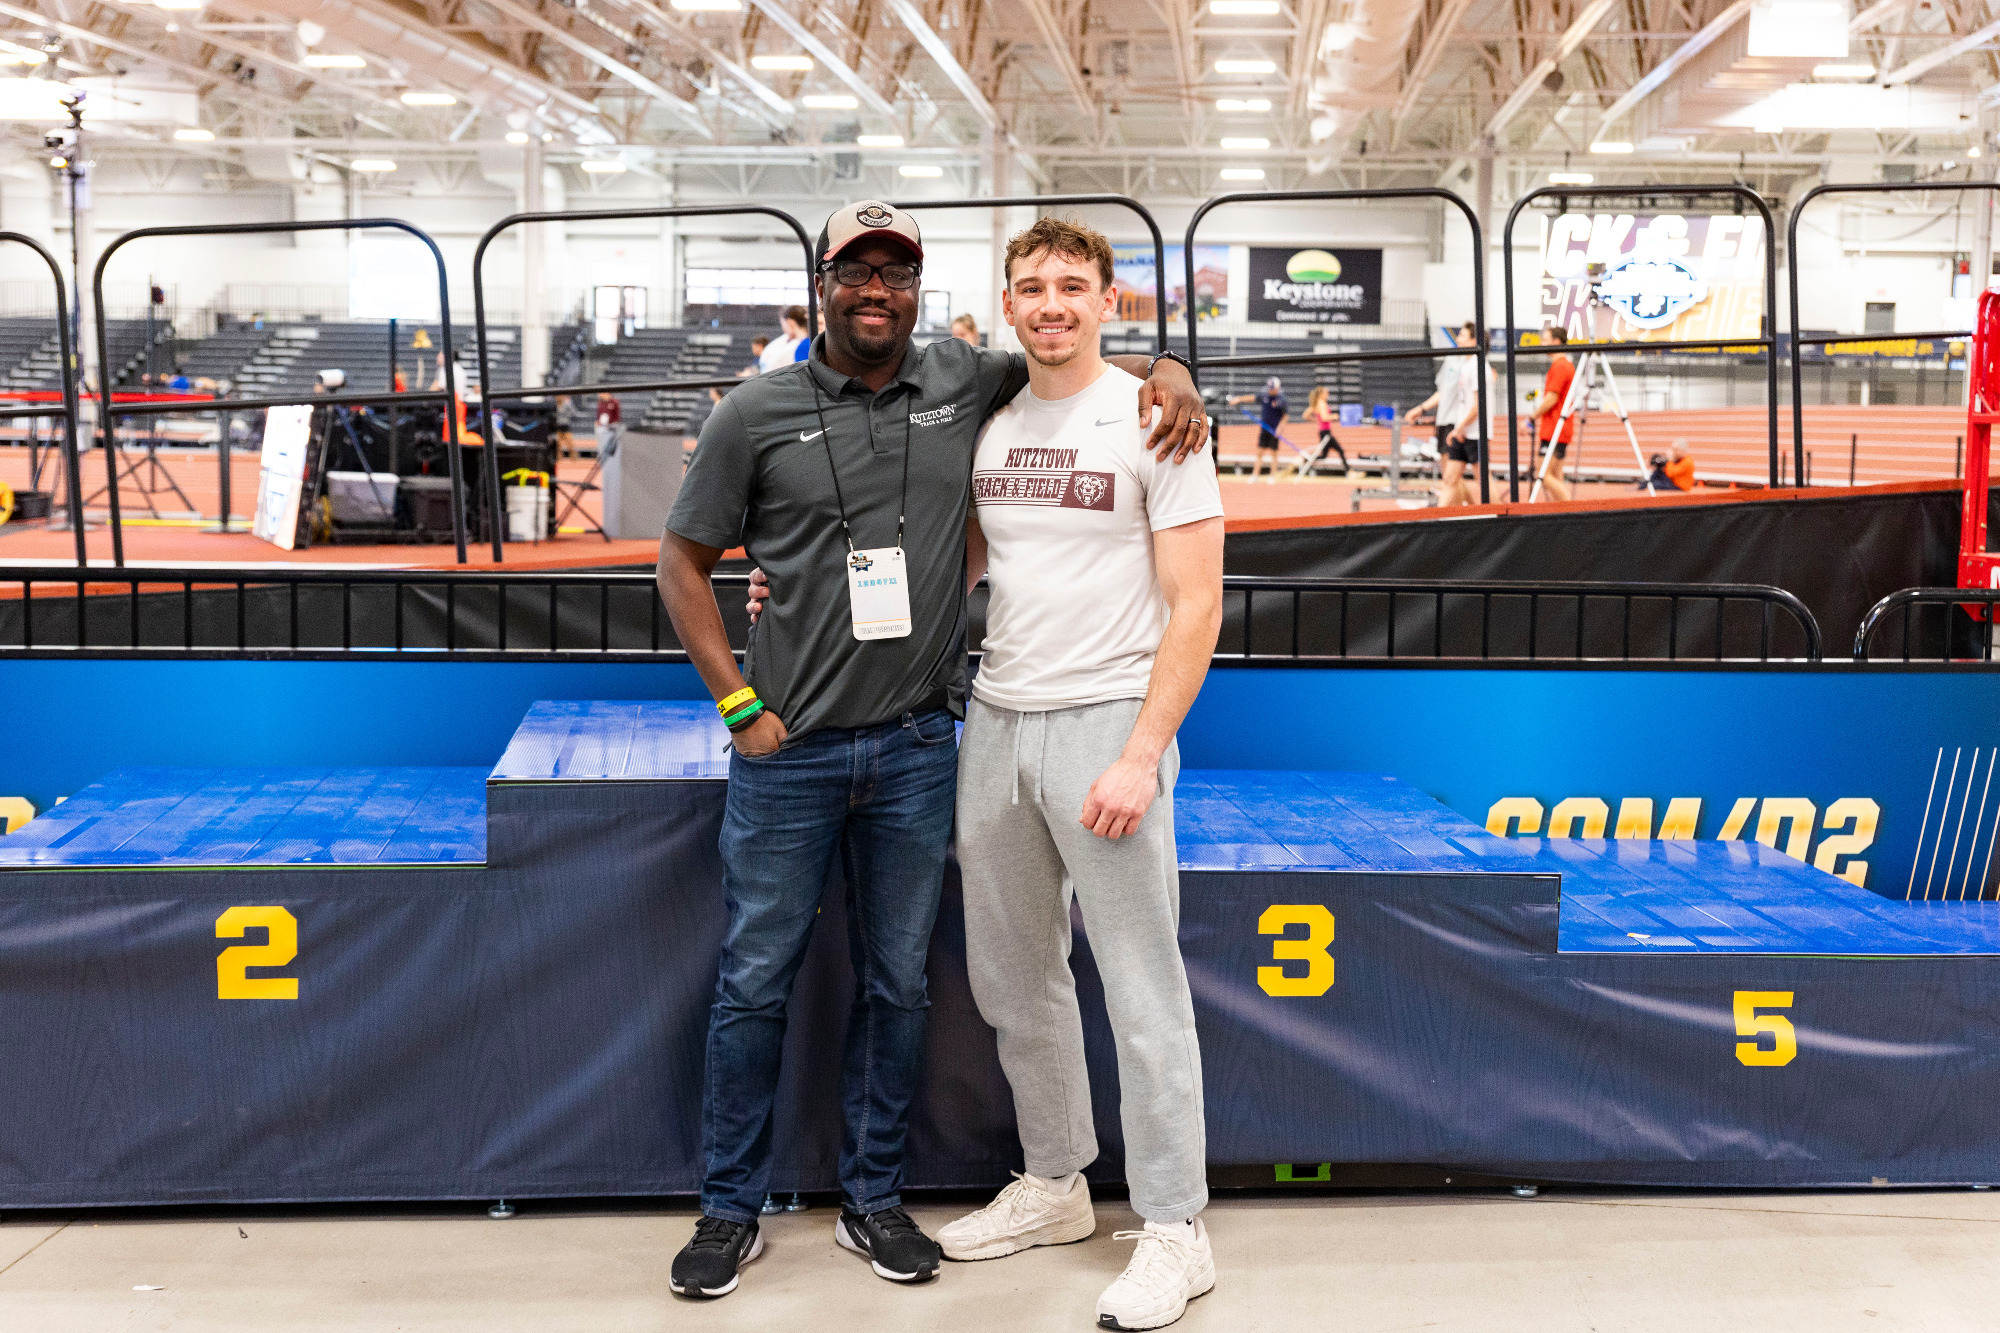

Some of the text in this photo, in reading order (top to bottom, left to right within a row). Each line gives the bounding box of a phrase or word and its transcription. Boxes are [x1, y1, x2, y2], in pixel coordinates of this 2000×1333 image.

[1263, 279, 1364, 305] Keystone
[909, 404, 955, 424] KUTZTOWN
[920, 420, 936, 428] TRACK
[1004, 448, 1079, 468] KUTZTOWN
[1023, 478, 1062, 499] FIELD
[215, 905, 298, 1000] 2
[1257, 904, 1335, 997] 3
[1732, 991, 1797, 1066] 5
